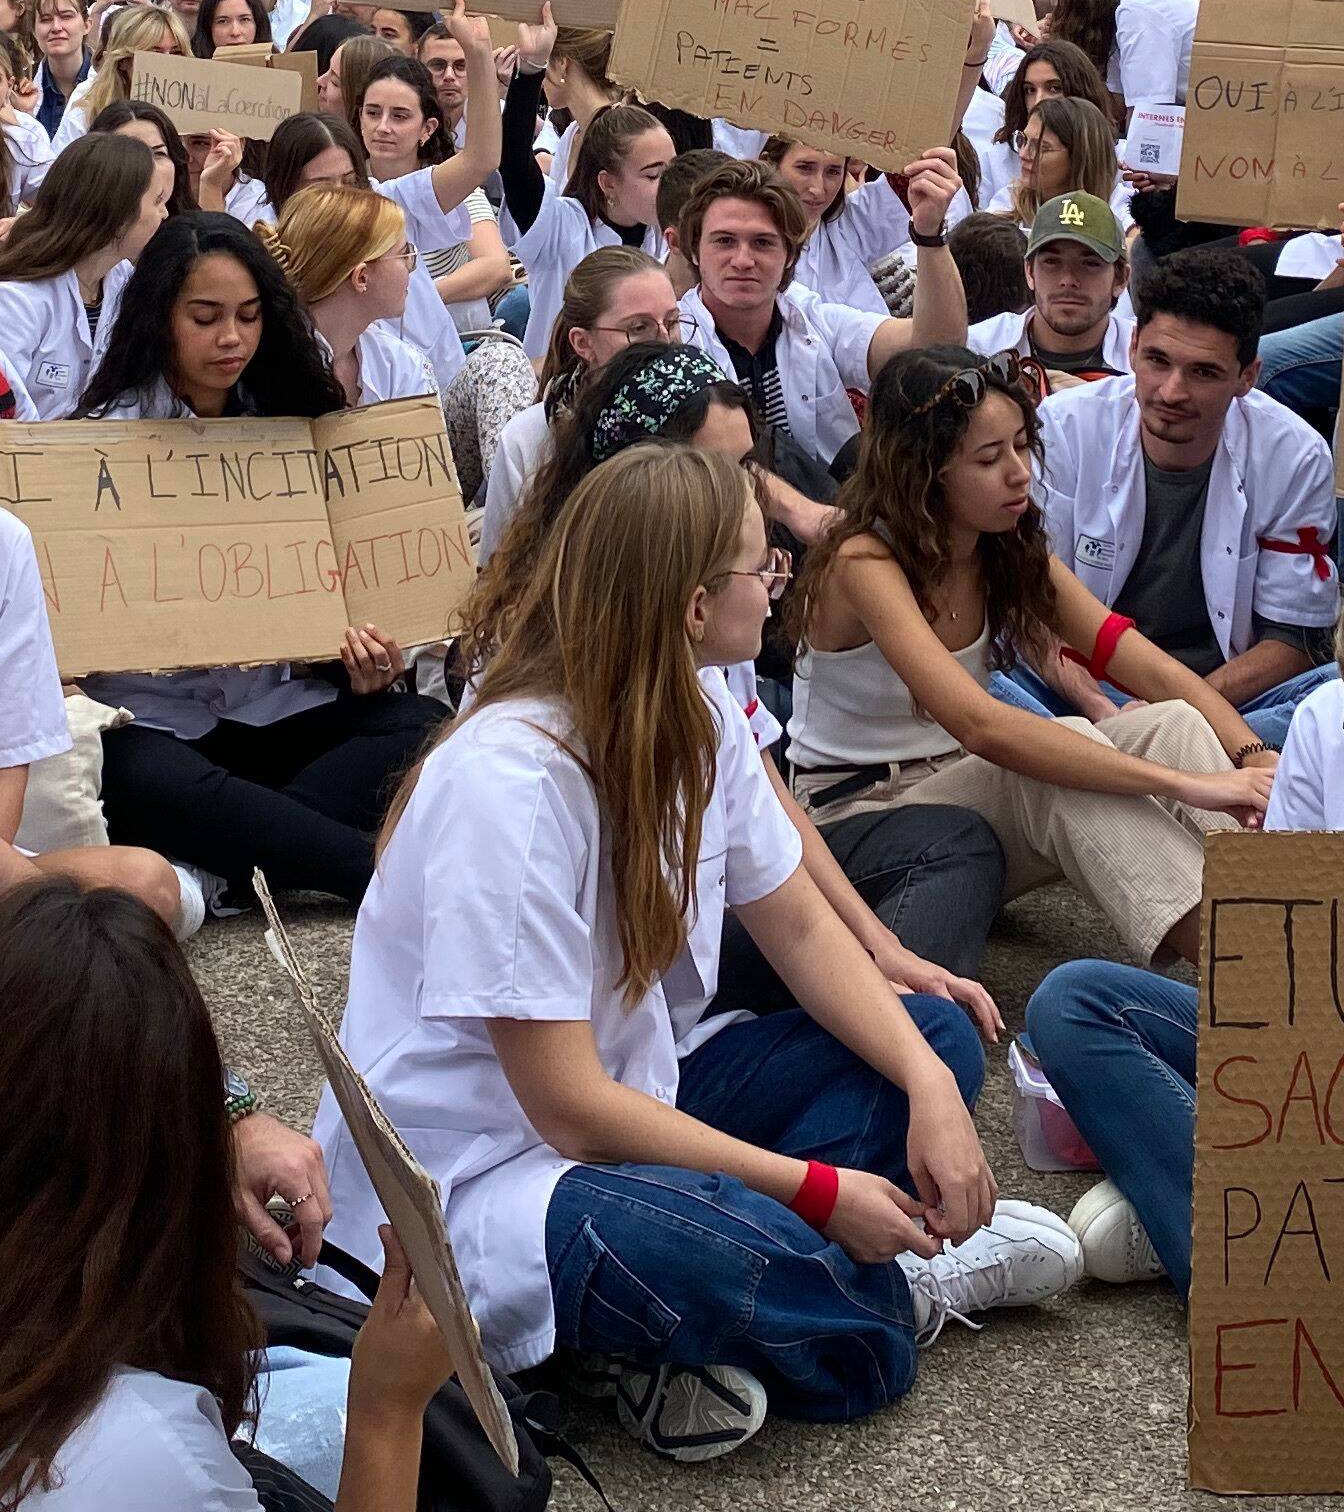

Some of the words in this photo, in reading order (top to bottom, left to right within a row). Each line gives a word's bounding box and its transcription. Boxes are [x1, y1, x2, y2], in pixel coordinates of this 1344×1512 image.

[677, 30, 813, 96] PATIENTS
[793, 10, 932, 62] FORMÉS
[713, 83, 763, 113] EN
[784, 99, 897, 153] DANGER
[1059, 198, 1085, 226] LA
[95, 449, 122, 511] À
[148, 432, 454, 502] L'INCITATION
[98, 537, 128, 614] À
[153, 525, 475, 605] L'OBLIGATION
